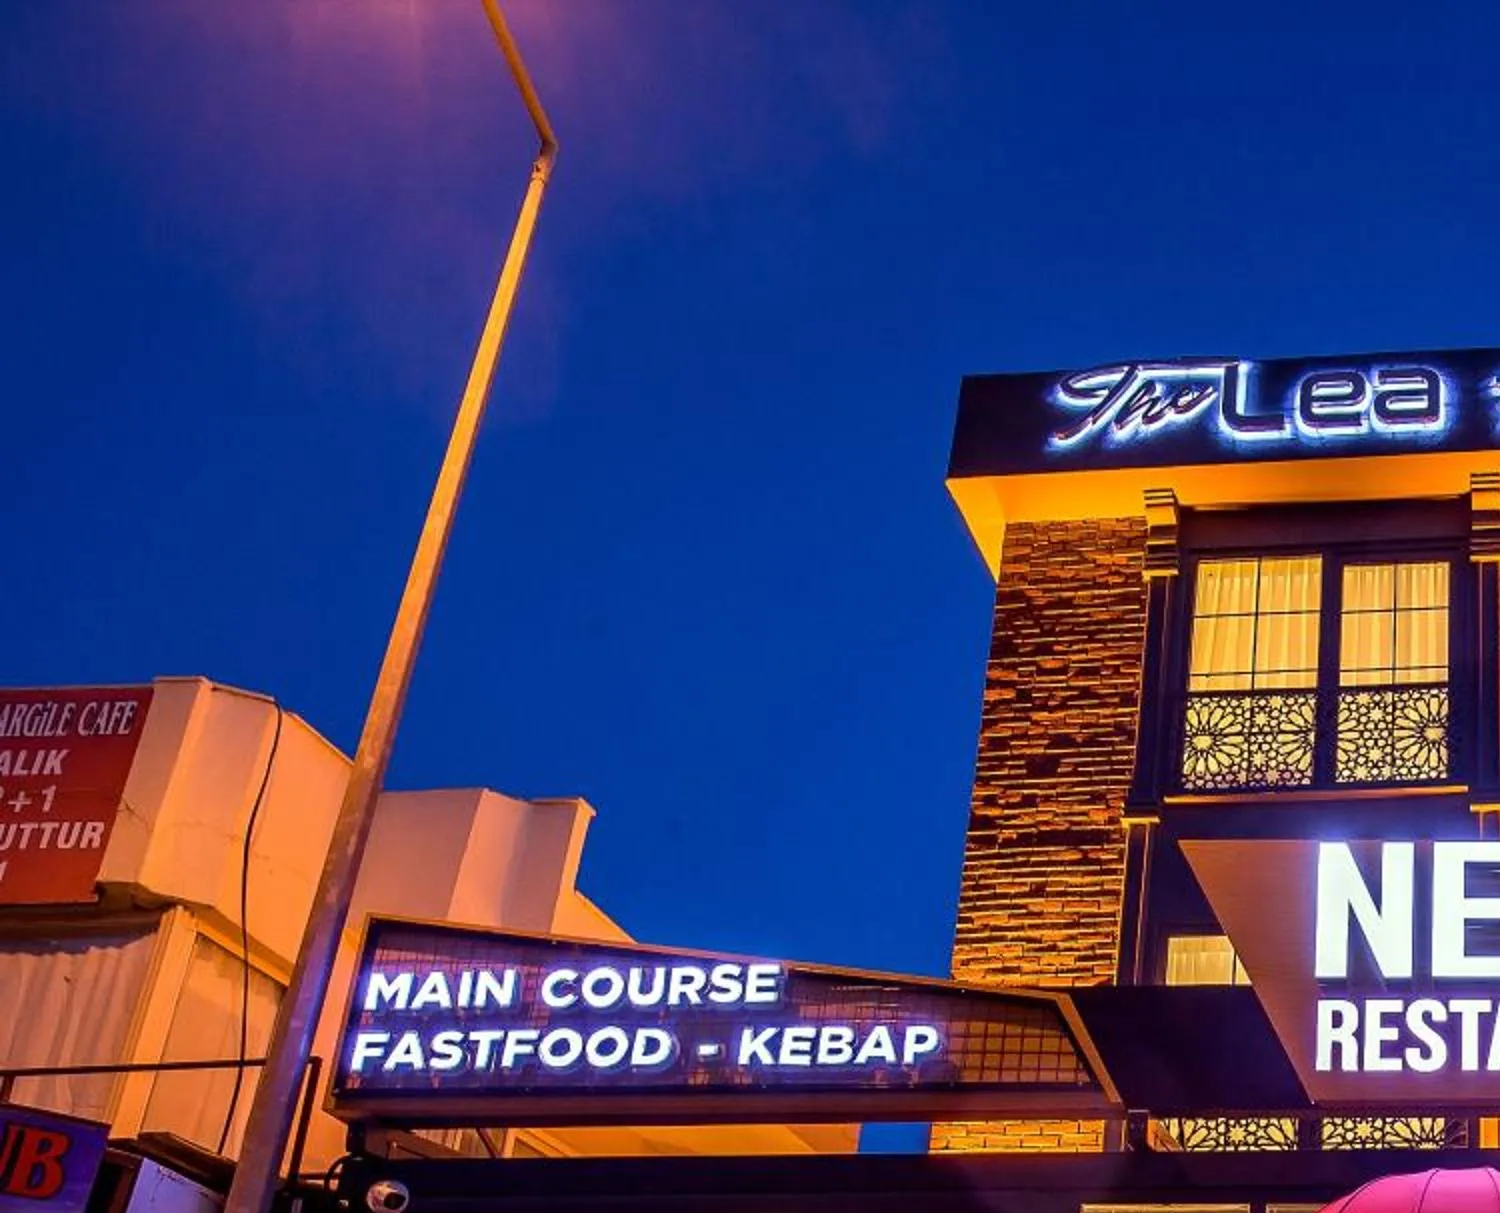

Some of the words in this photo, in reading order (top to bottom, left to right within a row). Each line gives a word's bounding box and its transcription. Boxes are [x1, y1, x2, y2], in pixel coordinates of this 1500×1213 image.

[1057, 357, 1240, 442] The
[1221, 361, 1444, 437] Lea
[78, 701, 138, 736] CAFE
[0, 749, 70, 776] ALIK
[363, 970, 517, 1011] MAIN
[541, 964, 781, 1008] COURSE
[351, 1026, 673, 1071] FASTFOOD
[738, 1025, 939, 1067] KEBAP
